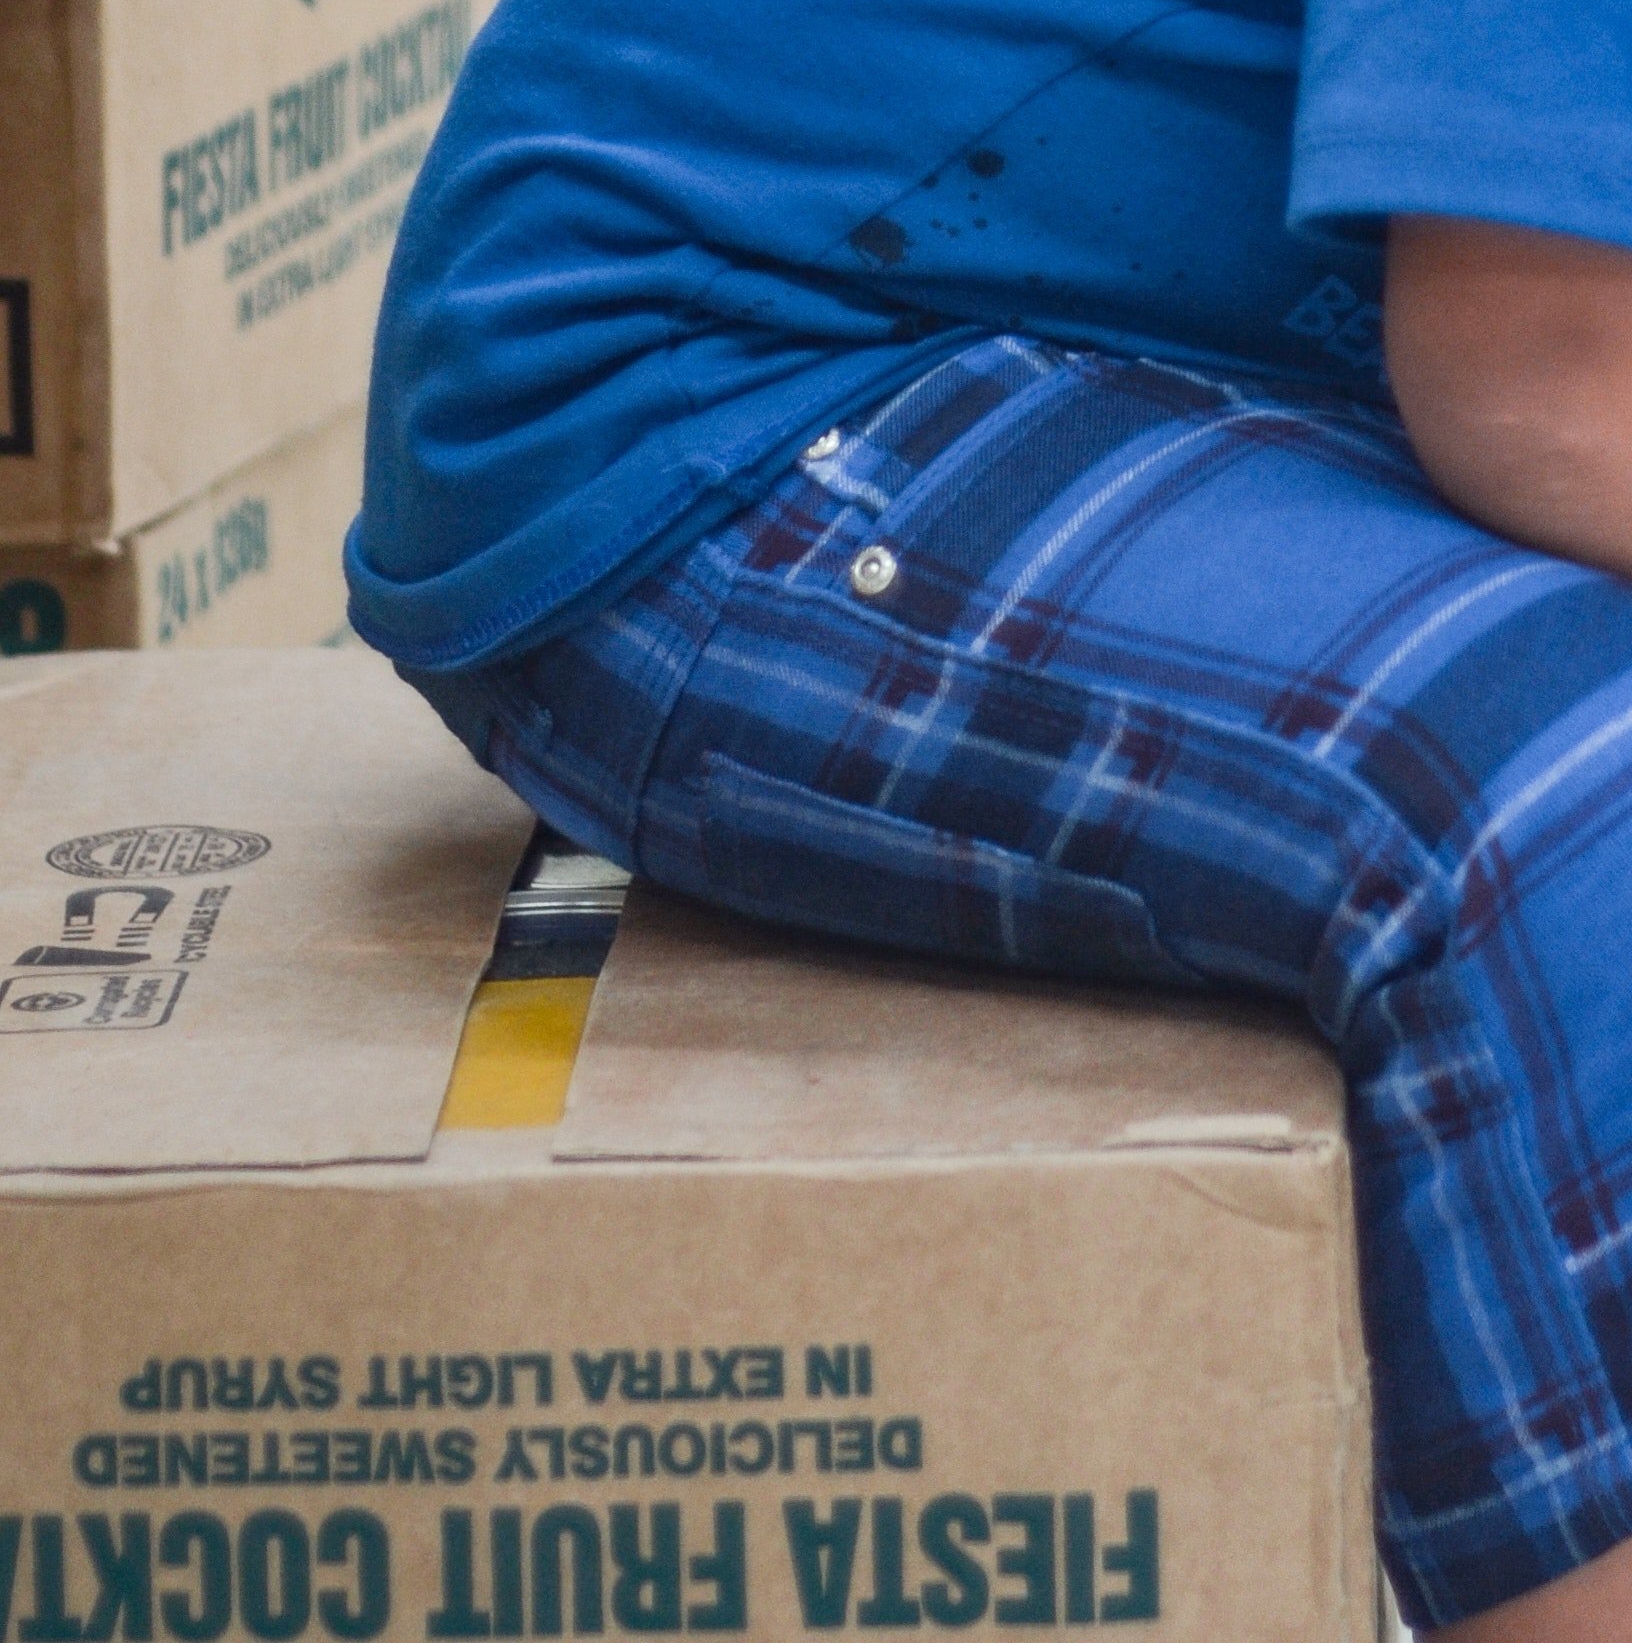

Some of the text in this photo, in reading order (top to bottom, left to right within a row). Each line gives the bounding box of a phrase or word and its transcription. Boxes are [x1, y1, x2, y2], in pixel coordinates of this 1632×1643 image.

[161, 107, 260, 258] FIESTA
[268, 54, 350, 195] FRUIT
[119, 1343, 873, 1413] IN EXTRA LIGHT SYRUP
[71, 1416, 923, 1489] DELICIOUSLY SWEETENED
[0, 1488, 1162, 1643] FIESTA FRUIT COCKT
